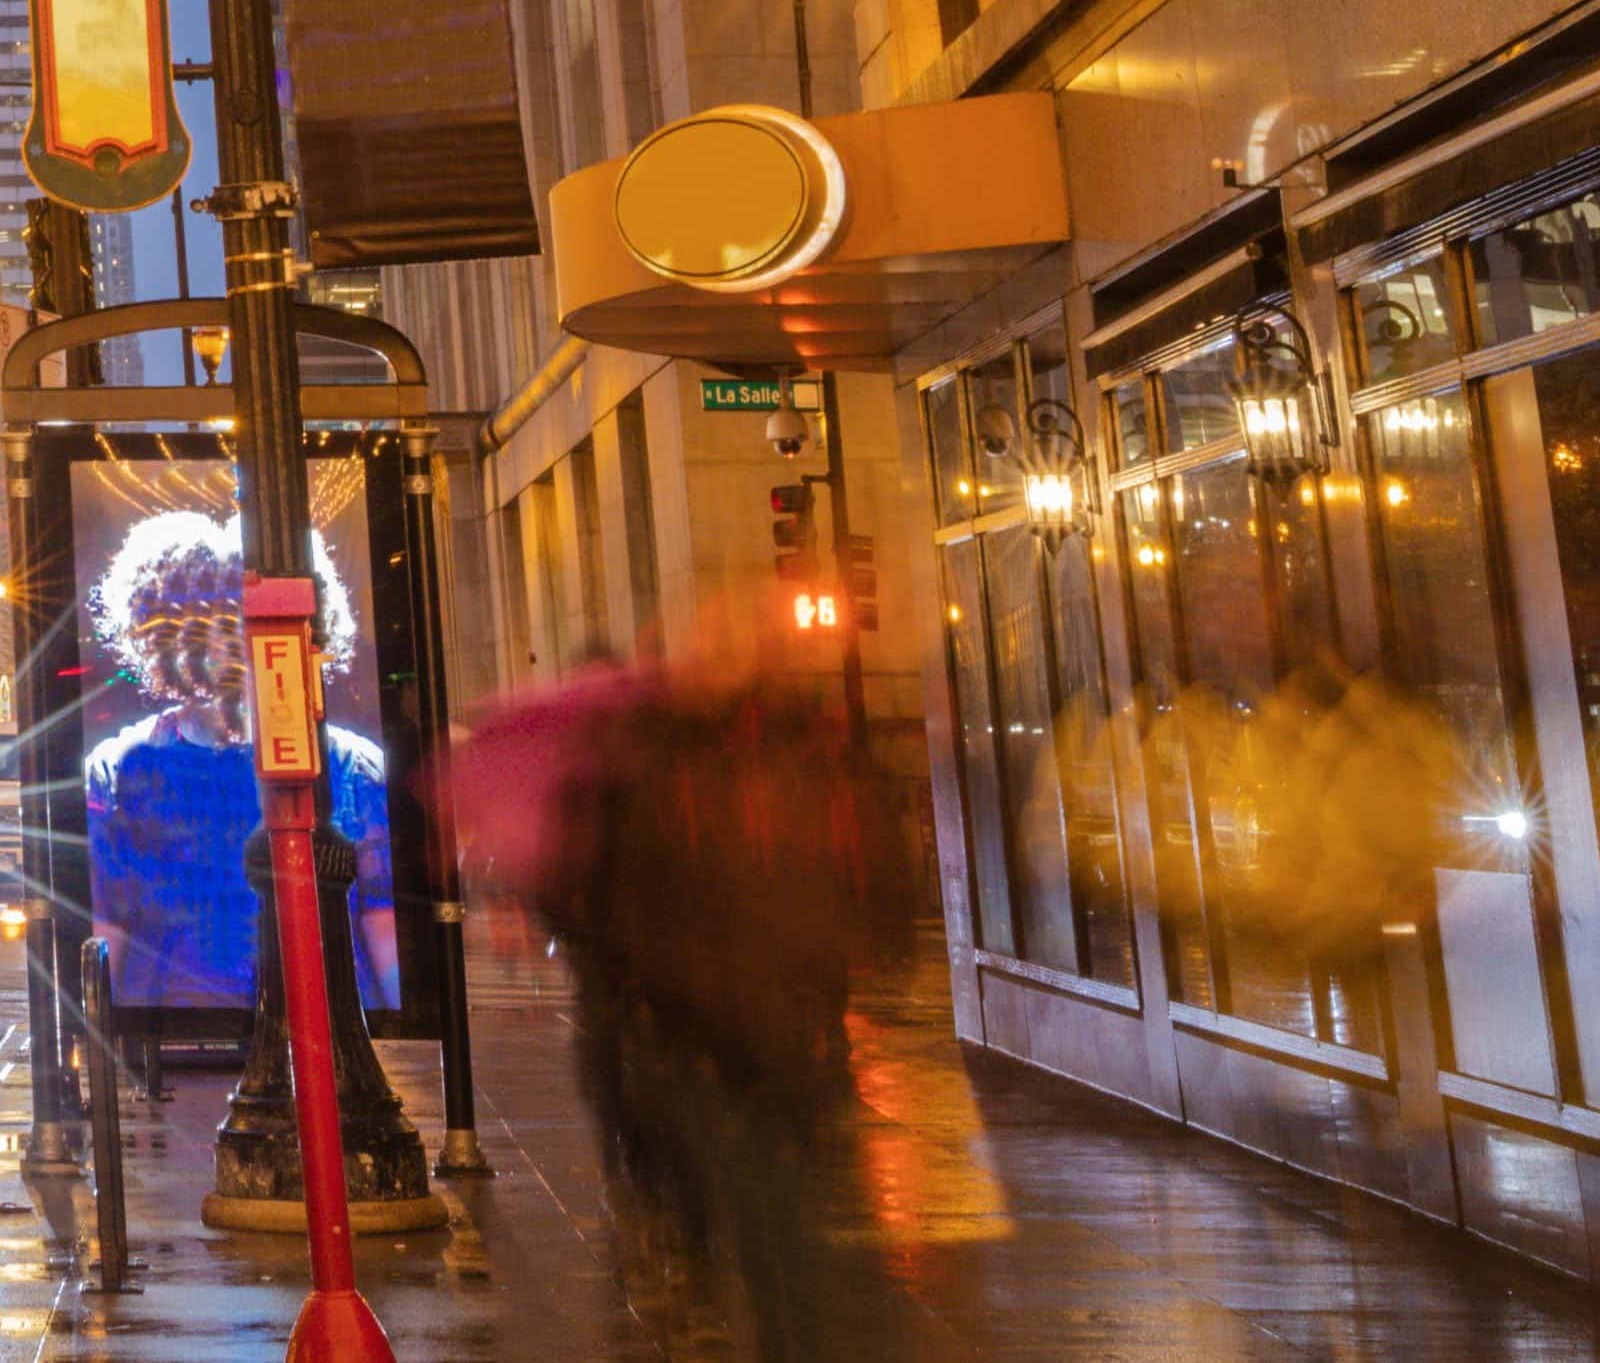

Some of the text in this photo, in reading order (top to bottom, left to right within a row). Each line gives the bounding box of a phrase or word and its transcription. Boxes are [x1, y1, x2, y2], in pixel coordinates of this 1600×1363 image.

[716, 386, 736, 404] La
[740, 386, 781, 404] Salle
[264, 640, 299, 765] FIE
